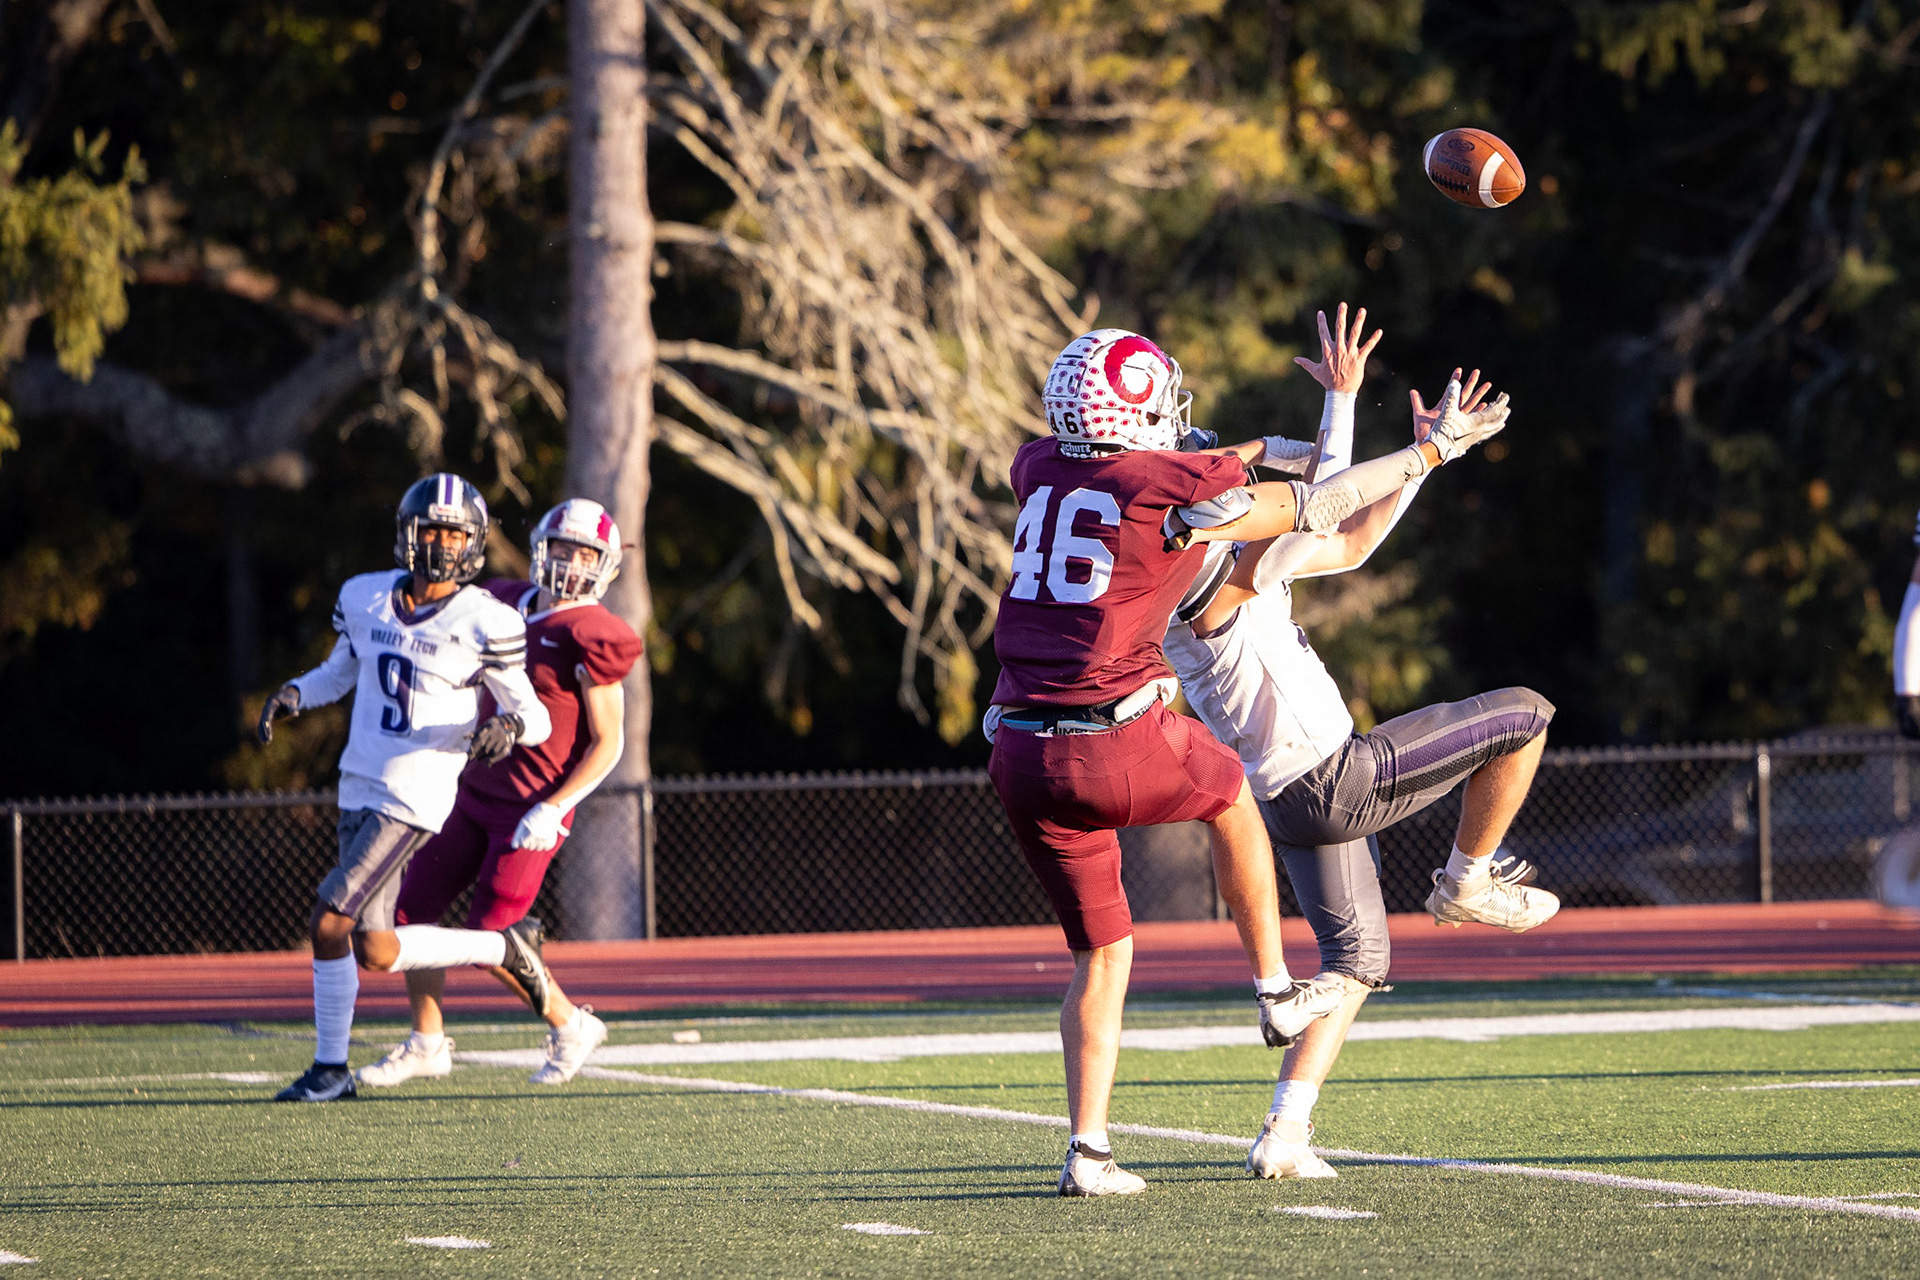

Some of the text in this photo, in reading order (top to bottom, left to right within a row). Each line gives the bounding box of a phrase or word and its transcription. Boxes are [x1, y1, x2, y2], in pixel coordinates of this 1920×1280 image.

[1009, 485, 1121, 603] 46
[371, 627, 437, 656] VALLEY TECH
[377, 652, 417, 737] 9
